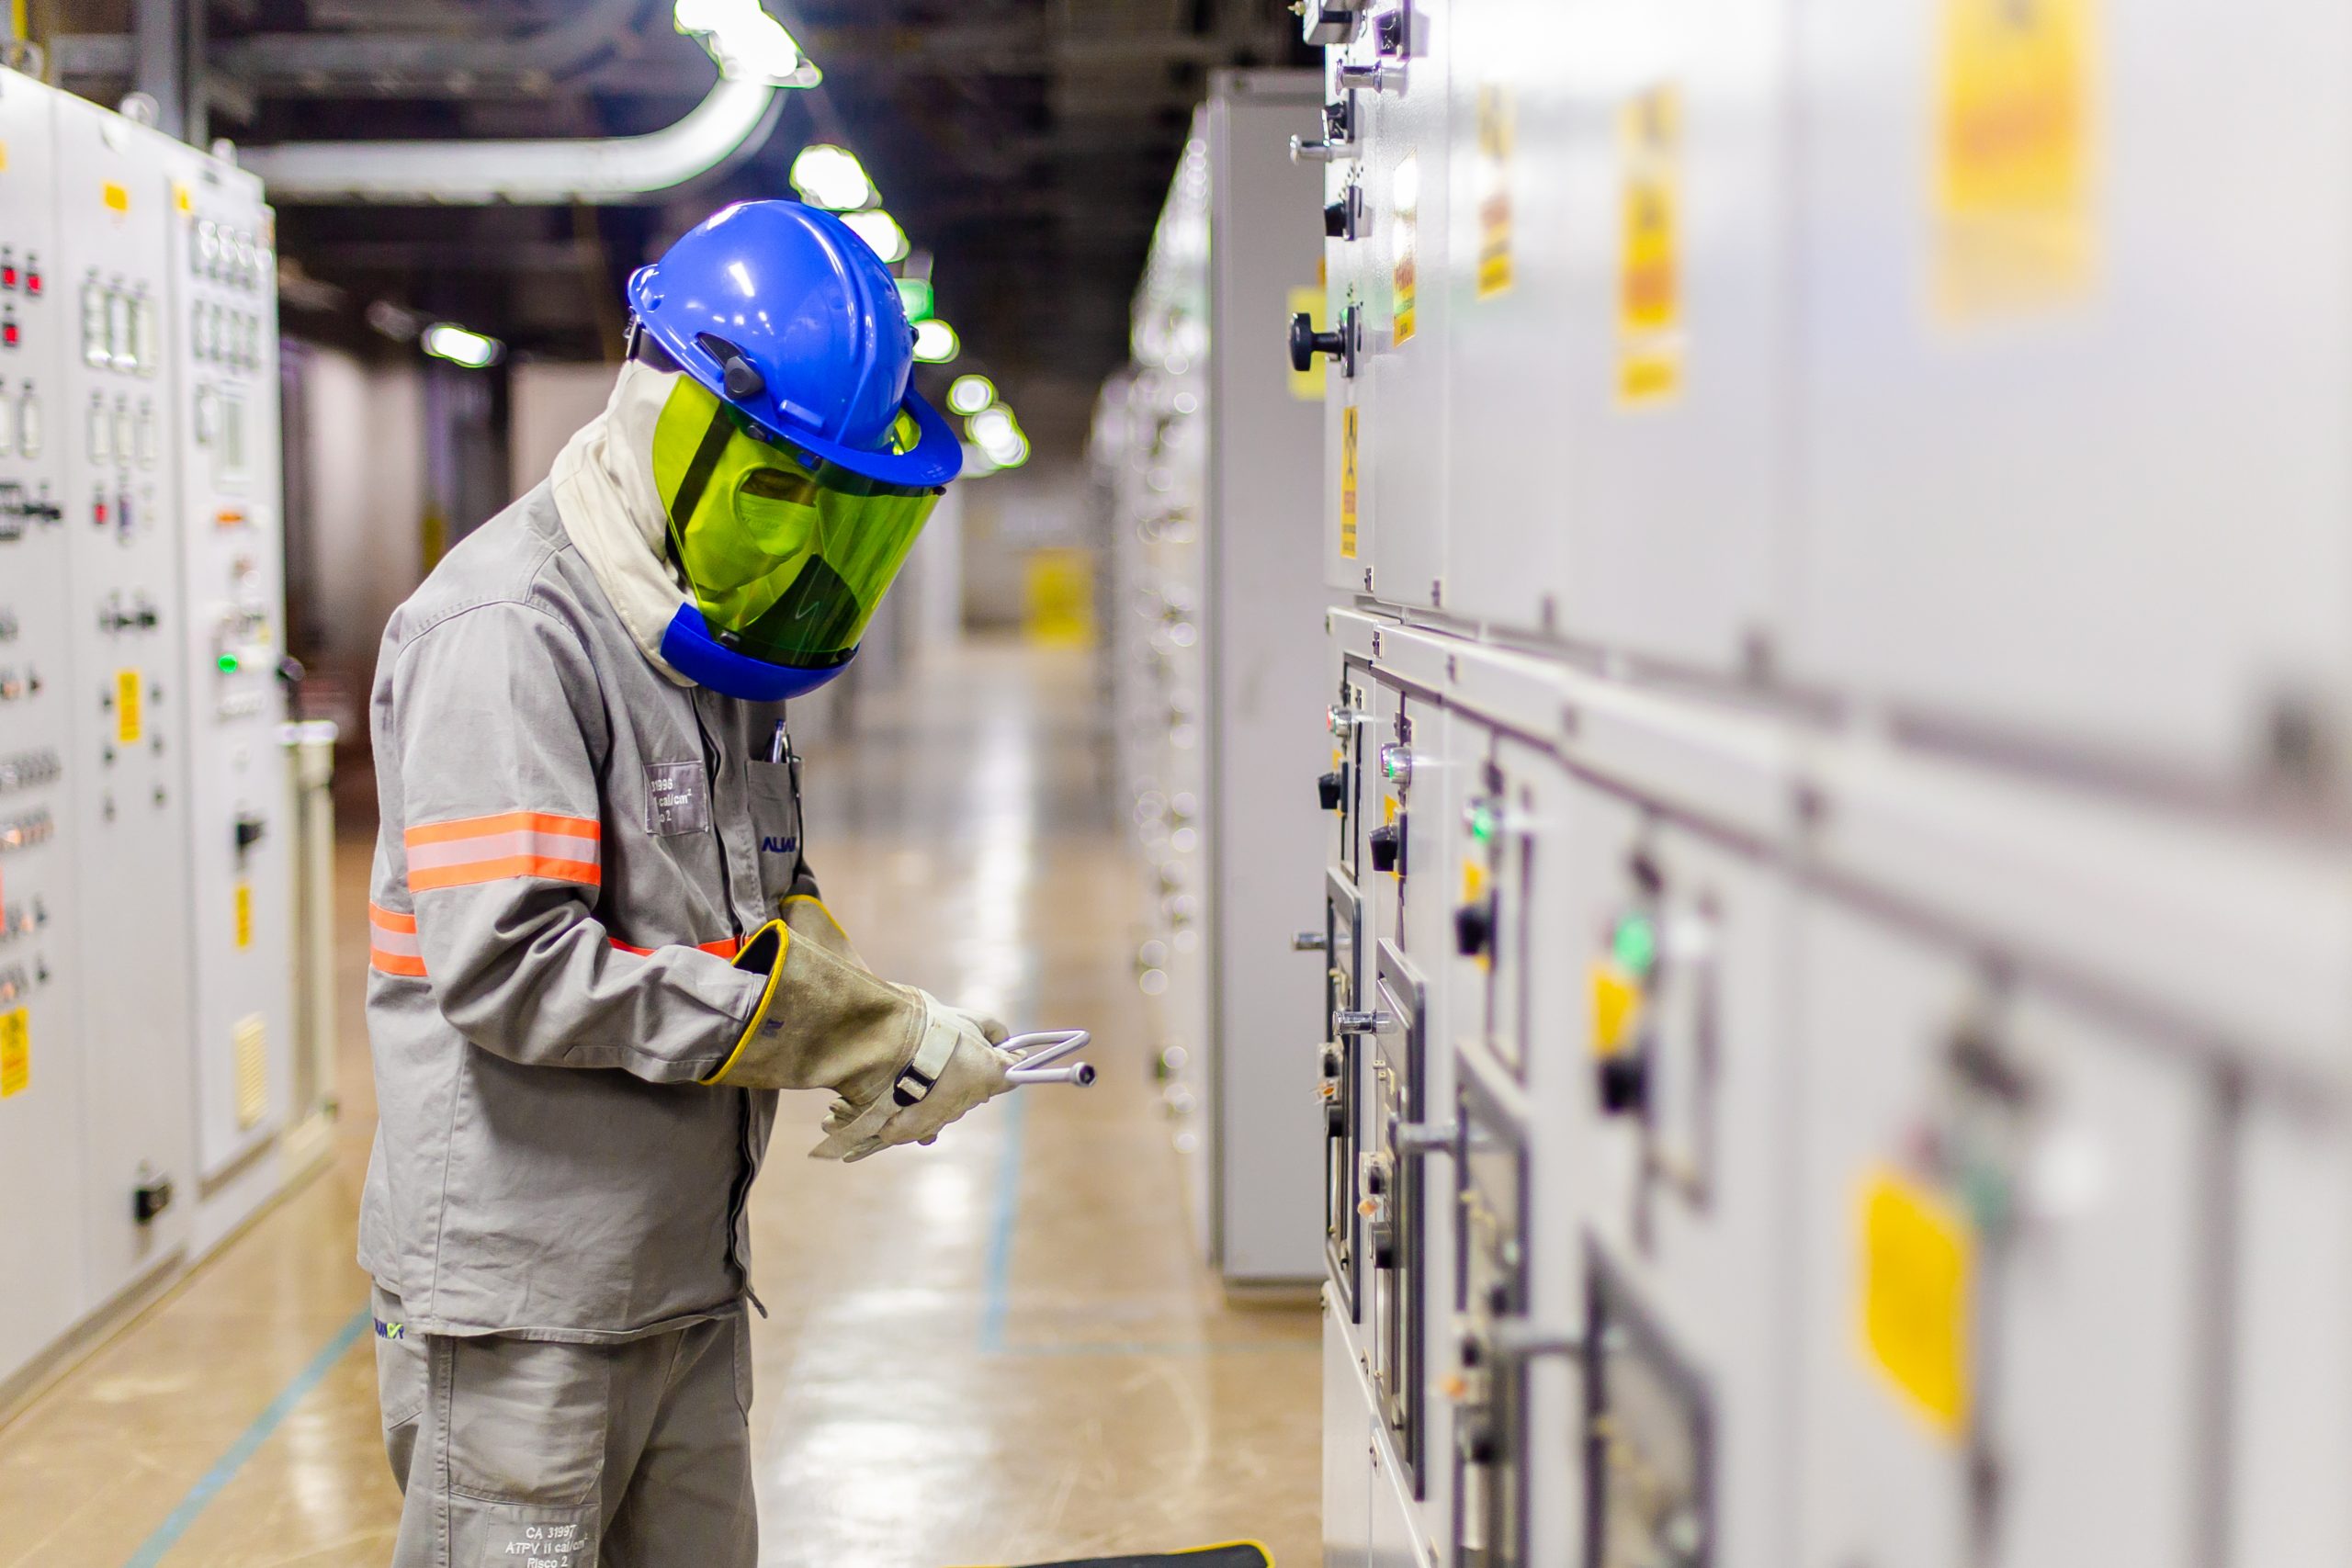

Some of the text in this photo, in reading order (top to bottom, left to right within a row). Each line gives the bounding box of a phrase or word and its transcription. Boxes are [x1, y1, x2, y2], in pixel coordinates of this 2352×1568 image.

[526, 1524, 577, 1540] CA 31997
[505, 1541, 540, 1555] ATPV
[527, 1555, 569, 1568] Risco 2
